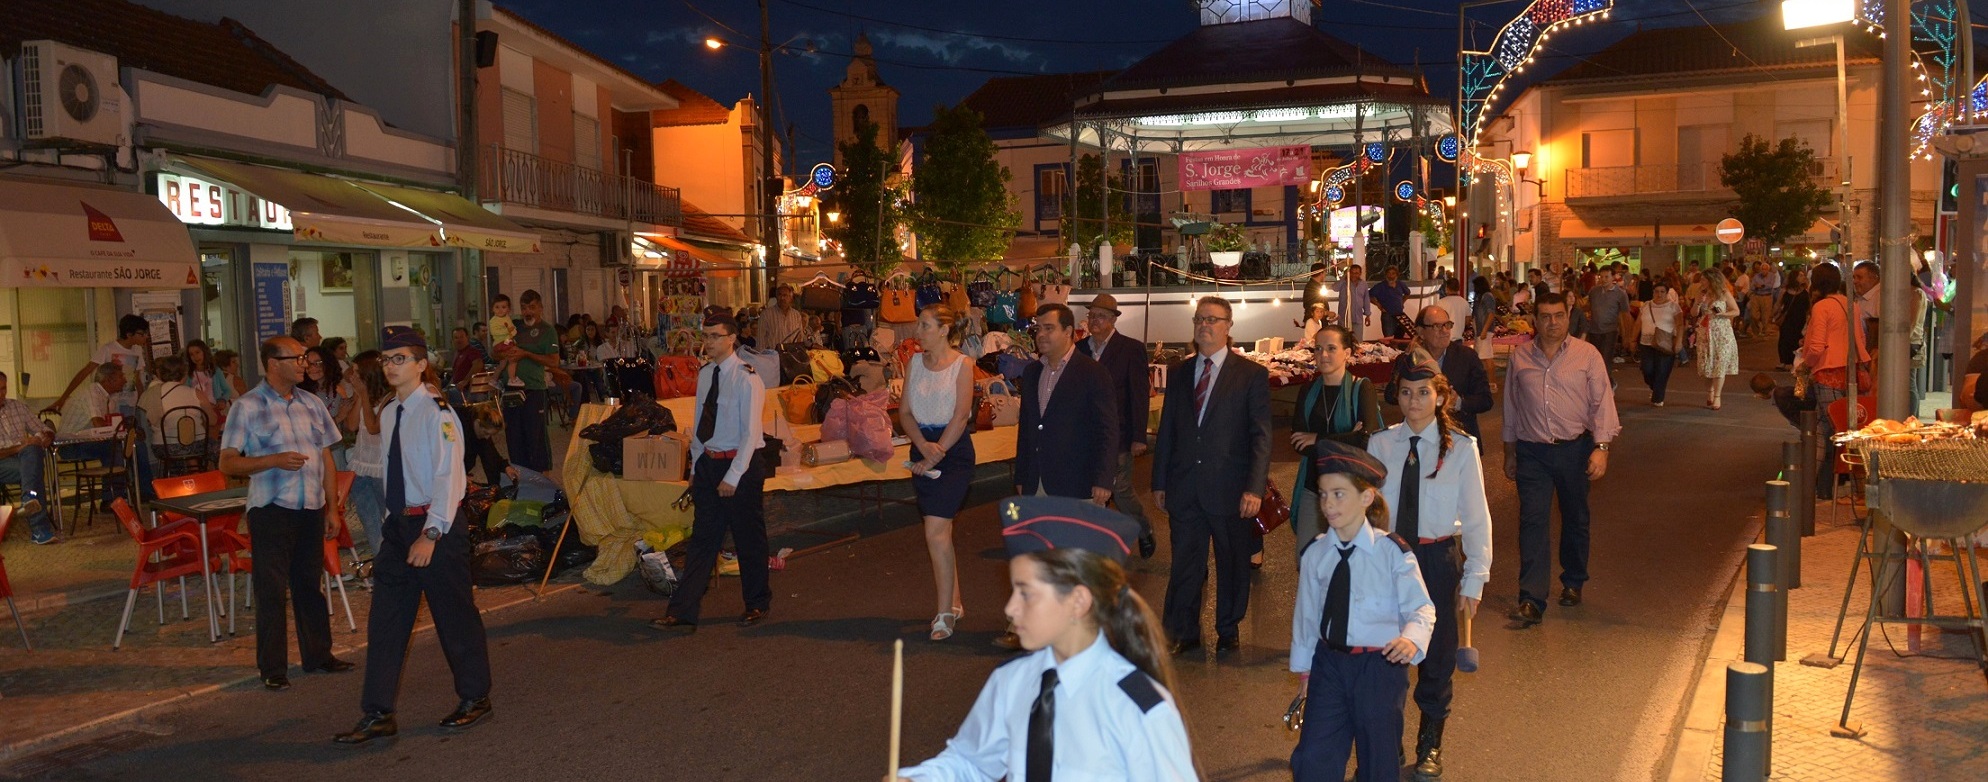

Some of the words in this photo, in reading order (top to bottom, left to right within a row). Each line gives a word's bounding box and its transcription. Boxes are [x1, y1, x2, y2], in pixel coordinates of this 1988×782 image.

[1214, 154, 1233, 162] Honra
[1233, 153, 1241, 161] de
[1185, 163, 1198, 178] S.
[1202, 162, 1242, 179] Jorge
[1185, 179, 1213, 188] Sarilhos
[1213, 178, 1242, 186] Grandes
[91, 221, 115, 232] DELTA
[69, 268, 113, 280] Restaurante
[113, 266, 132, 280] SÃO
[134, 268, 162, 280] JORGE
